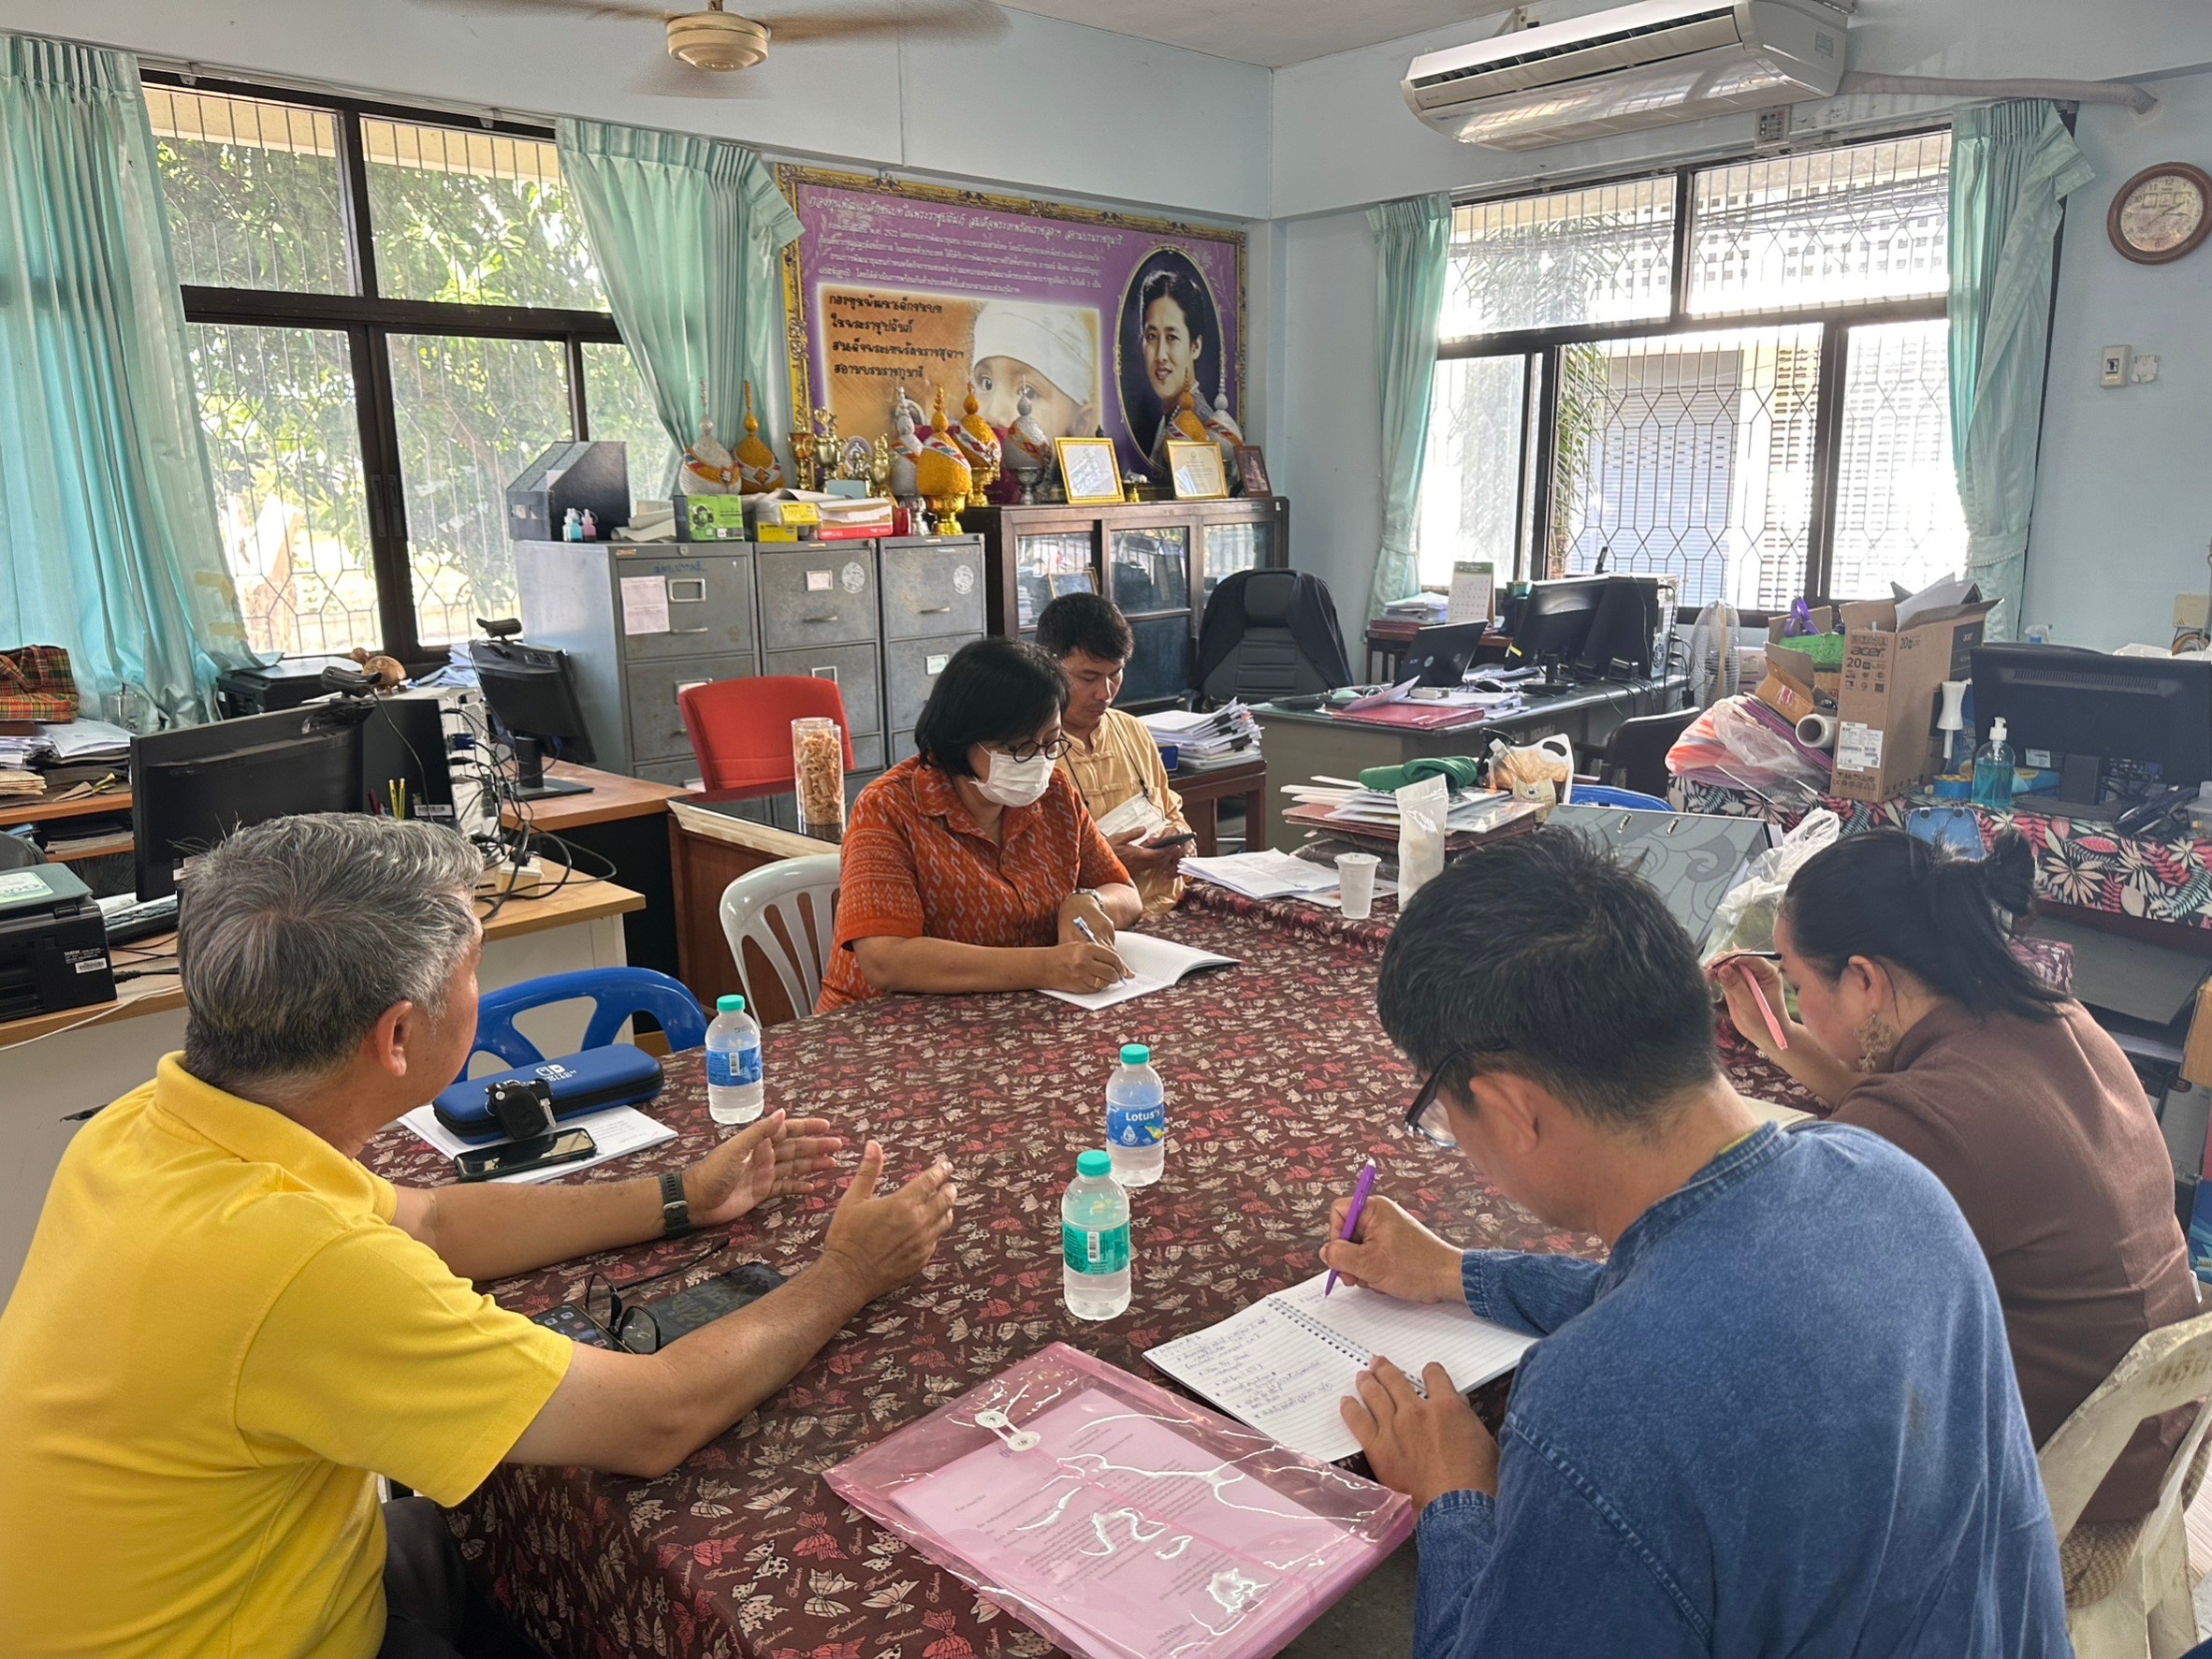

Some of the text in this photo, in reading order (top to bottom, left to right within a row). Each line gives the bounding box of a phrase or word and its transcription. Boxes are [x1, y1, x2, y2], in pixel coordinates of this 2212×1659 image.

[1850, 646, 1886, 657] acer
[1846, 657, 1862, 668] 20
[709, 1516, 749, 1536] Fashion
[752, 1526, 797, 1541] Fashion
[705, 1566, 750, 1579] Fashion
[865, 1568, 904, 1592] Fashion
[826, 1614, 868, 1639] Fashion
[753, 1625, 793, 1656] Fashion
[875, 1628, 924, 1645] Fashion
